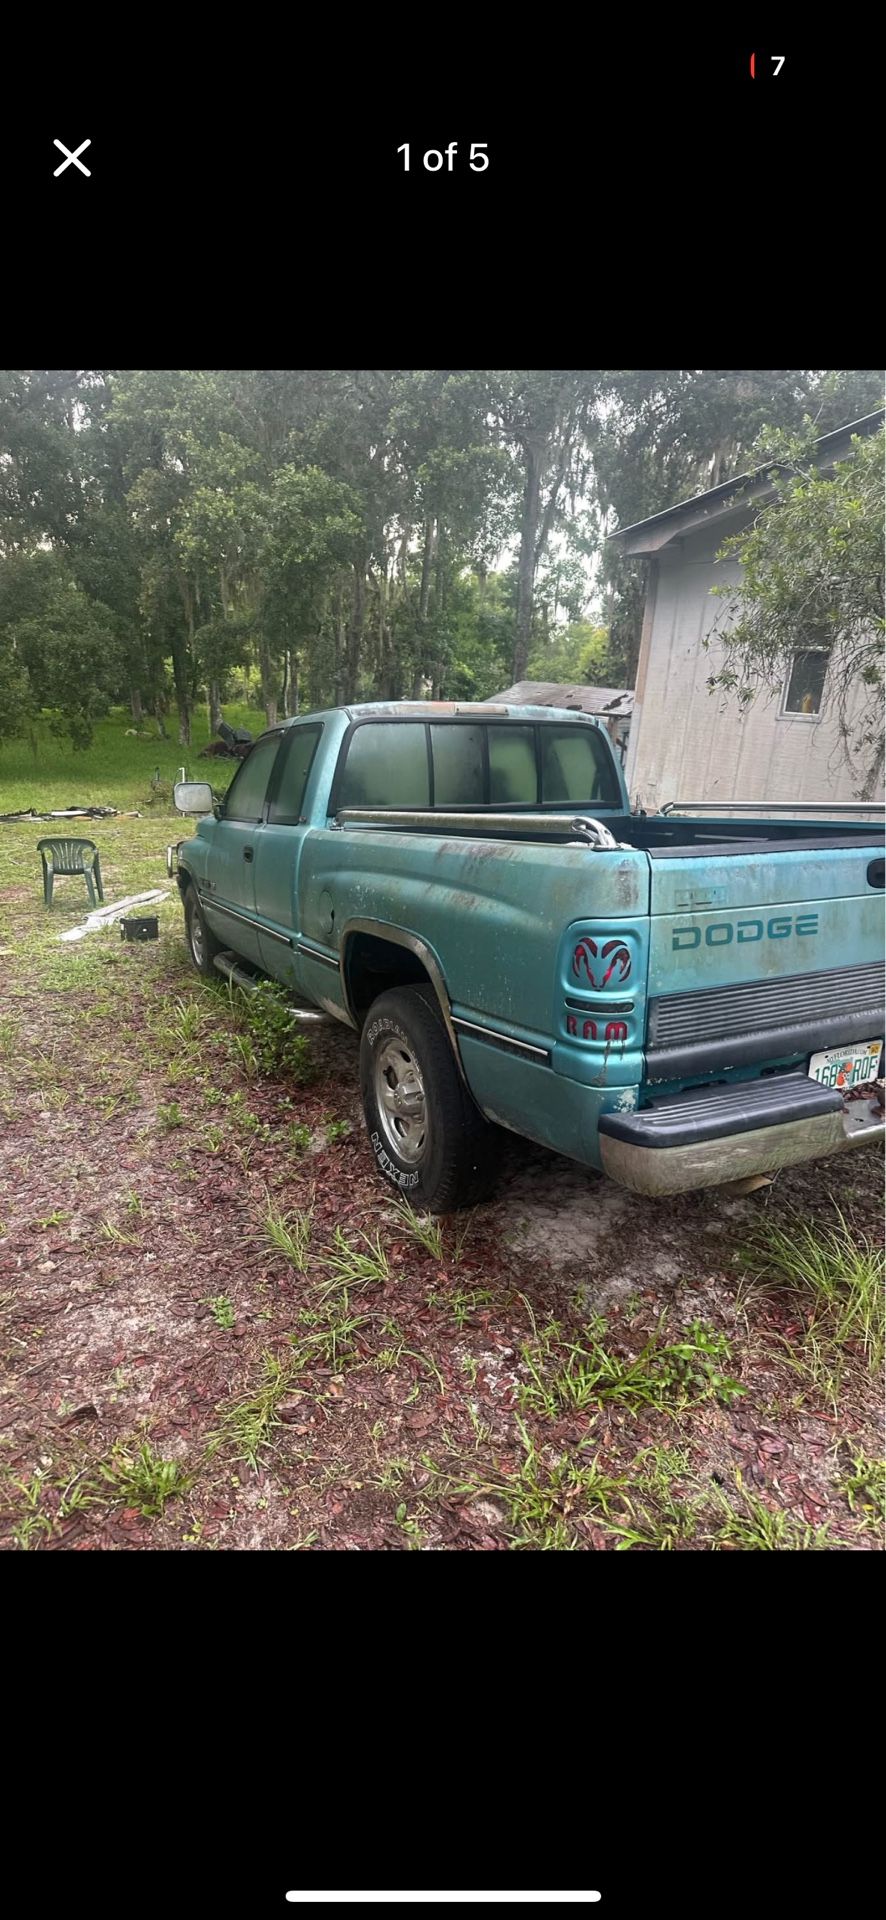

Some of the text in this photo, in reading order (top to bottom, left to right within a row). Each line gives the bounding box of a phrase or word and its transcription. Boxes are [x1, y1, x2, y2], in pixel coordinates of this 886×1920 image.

[672, 914, 818, 950] DODGE
[567, 1015, 627, 1041] RAM
[371, 1131, 419, 1186] NEXEN
